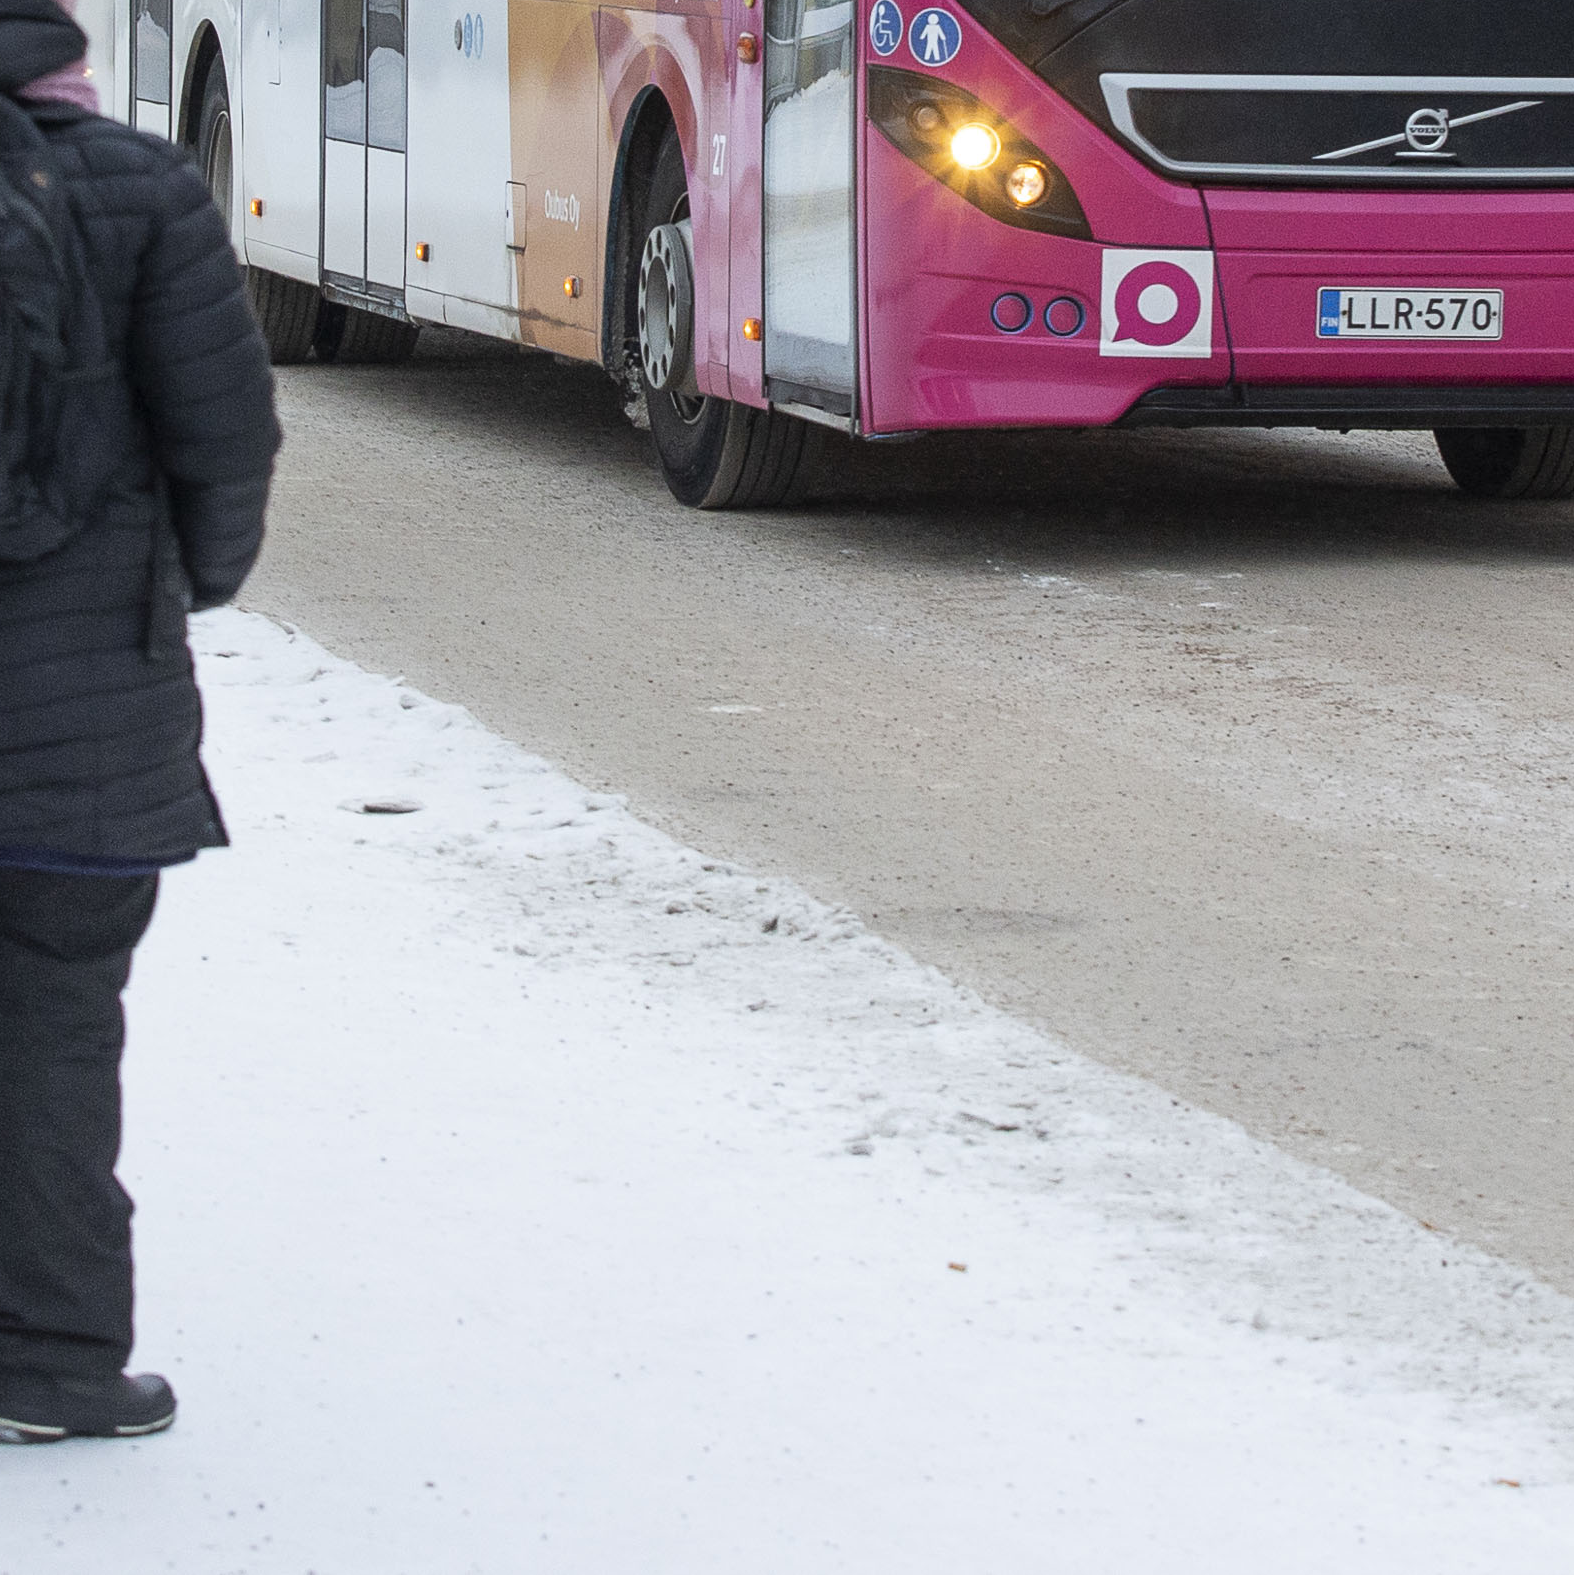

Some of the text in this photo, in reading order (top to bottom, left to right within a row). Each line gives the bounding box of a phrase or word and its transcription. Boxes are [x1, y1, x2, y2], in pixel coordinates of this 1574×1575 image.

[712, 133, 727, 176] 27
[1321, 296, 1492, 331] FIN LLR-570
